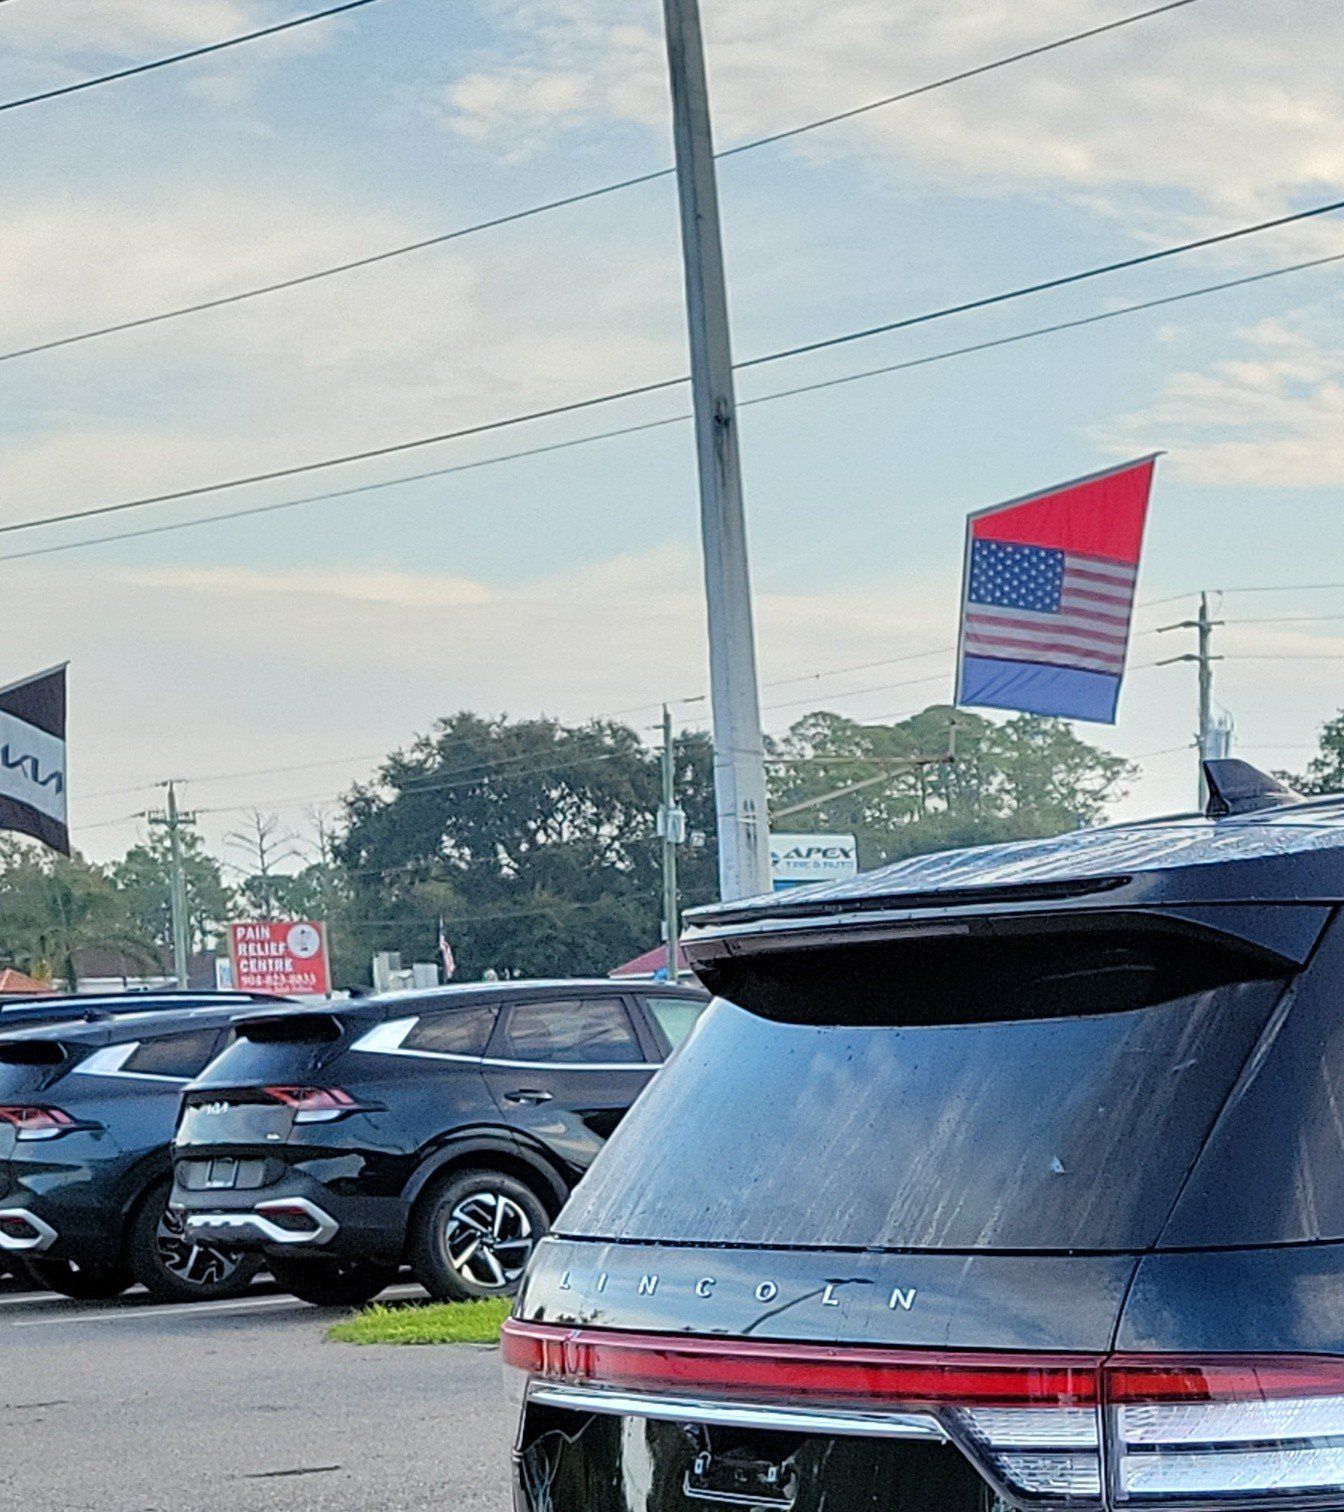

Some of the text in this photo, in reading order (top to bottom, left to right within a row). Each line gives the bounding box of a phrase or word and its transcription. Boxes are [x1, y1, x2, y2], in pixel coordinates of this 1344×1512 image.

[783, 847, 854, 859] APEX
[236, 925, 271, 940] PAIN
[238, 942, 287, 956] RELIEF
[240, 958, 293, 973] CENTRE
[559, 1270, 917, 1311] LINCOLN
